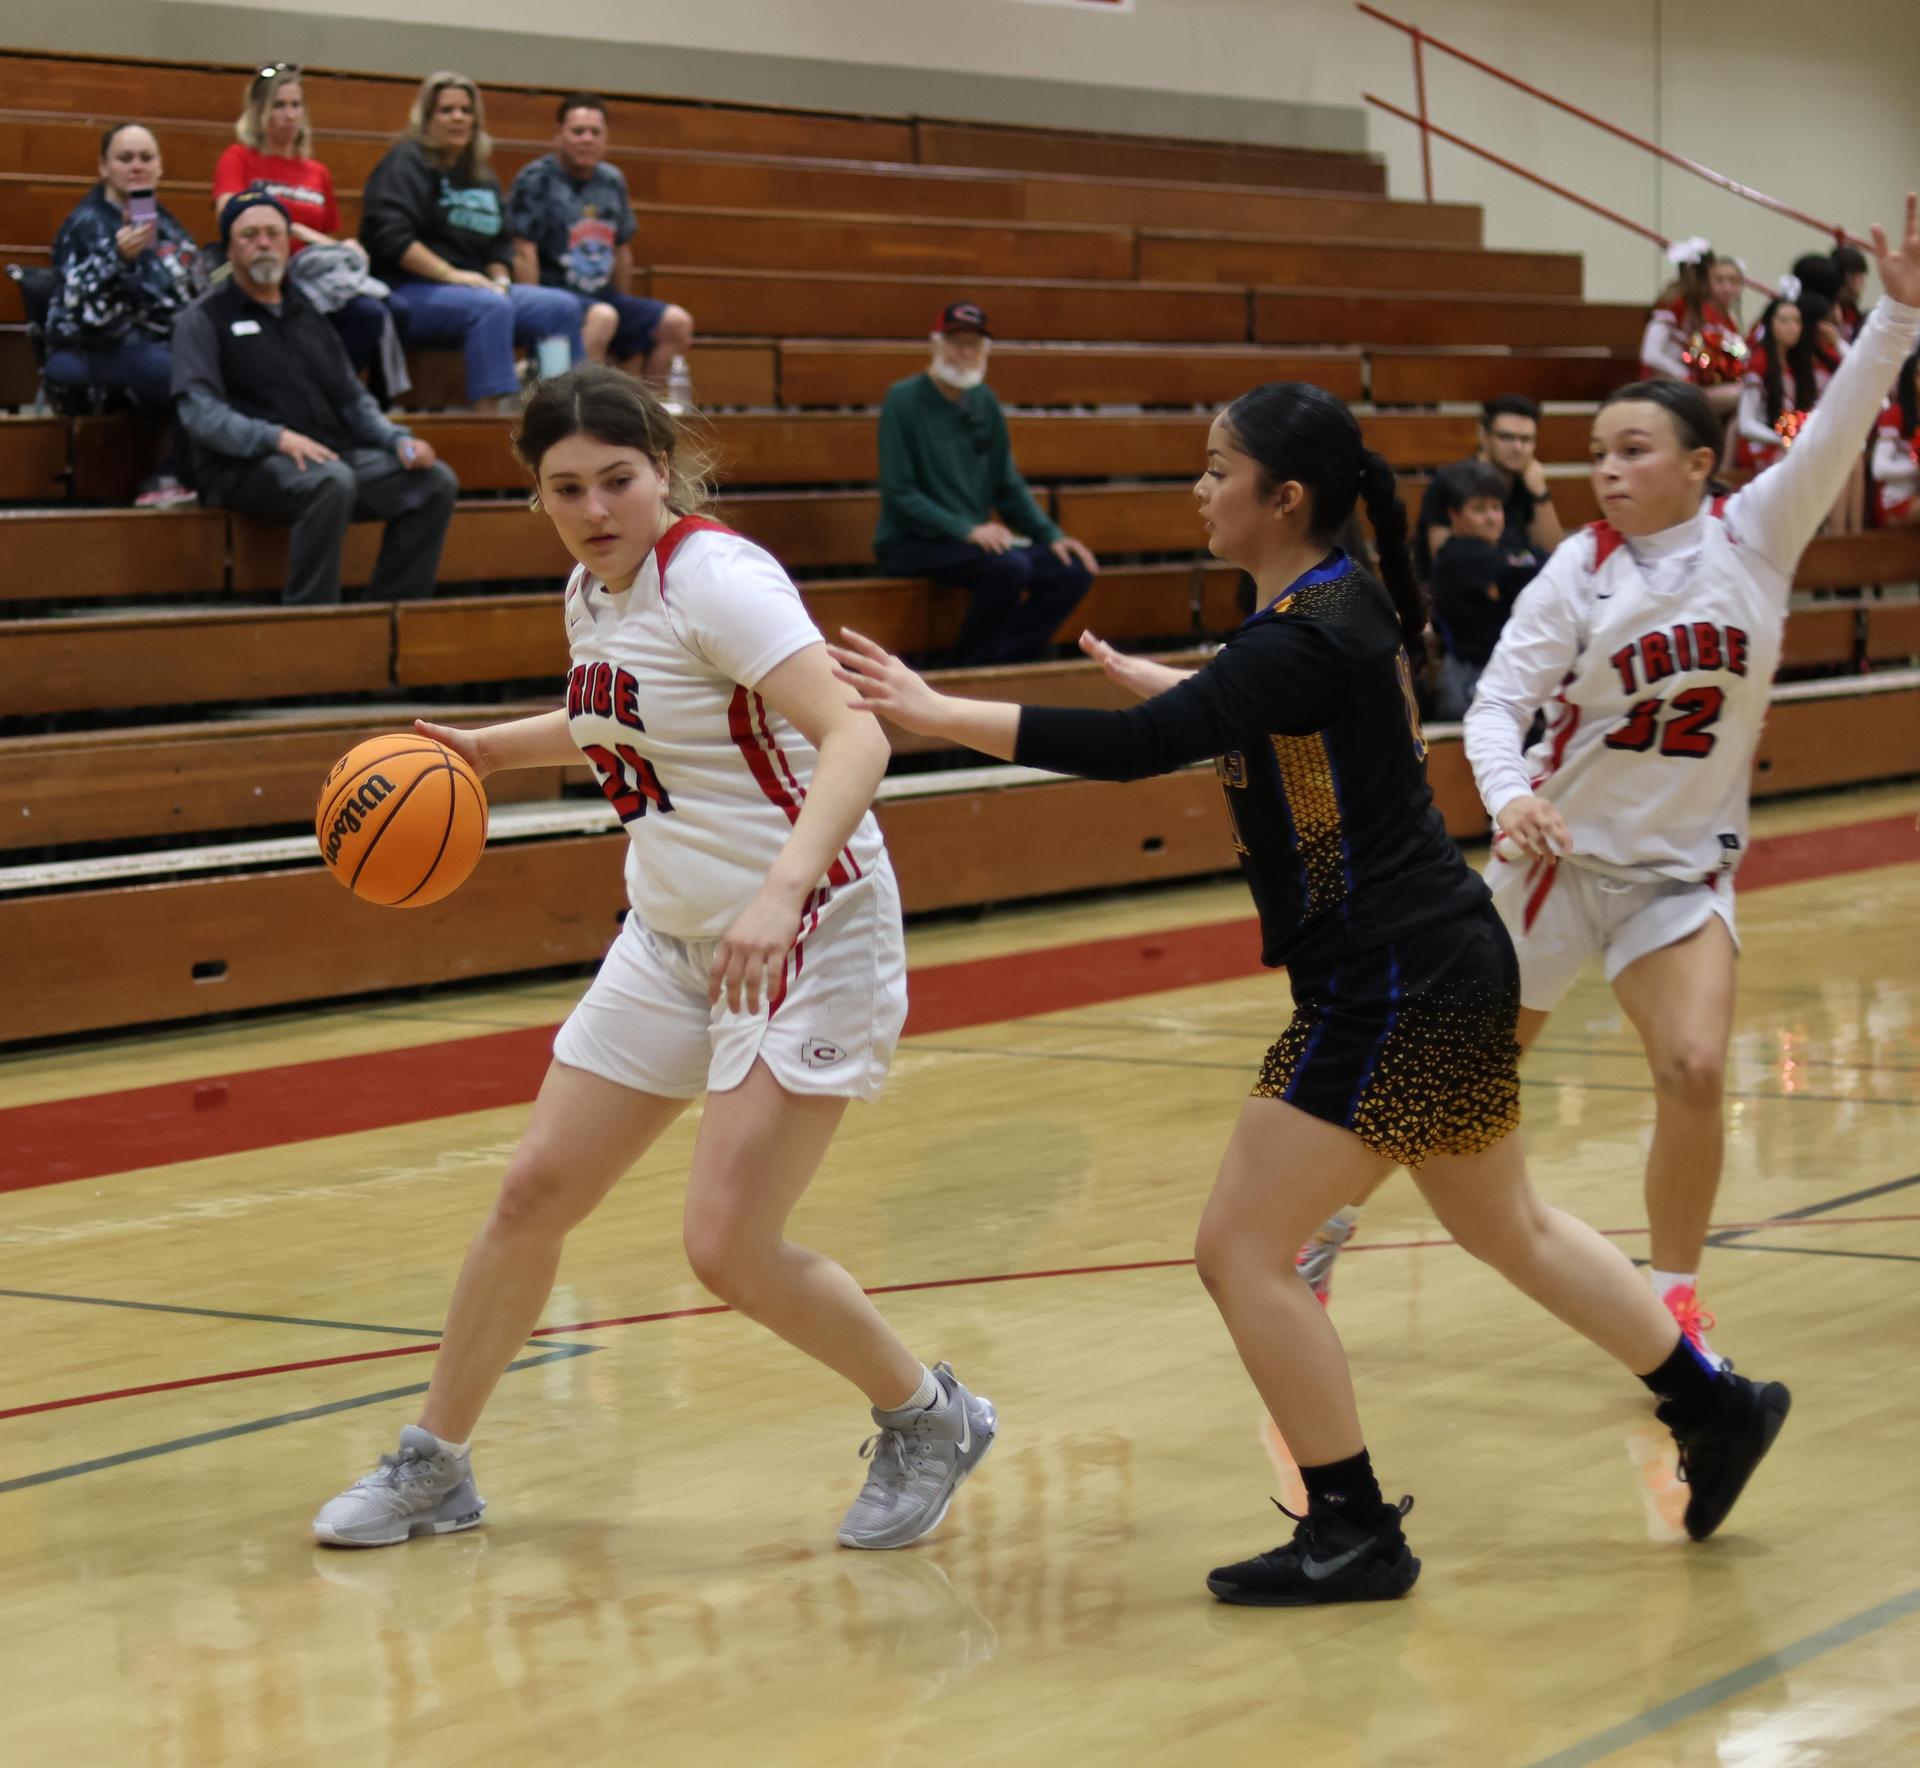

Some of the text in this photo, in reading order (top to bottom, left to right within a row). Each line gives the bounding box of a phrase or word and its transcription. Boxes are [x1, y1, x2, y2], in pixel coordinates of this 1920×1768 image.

[1610, 622, 1747, 694] TRIBE
[567, 662, 646, 733] RIBE
[326, 773, 396, 866] Wilson
[581, 743, 676, 824] 21
